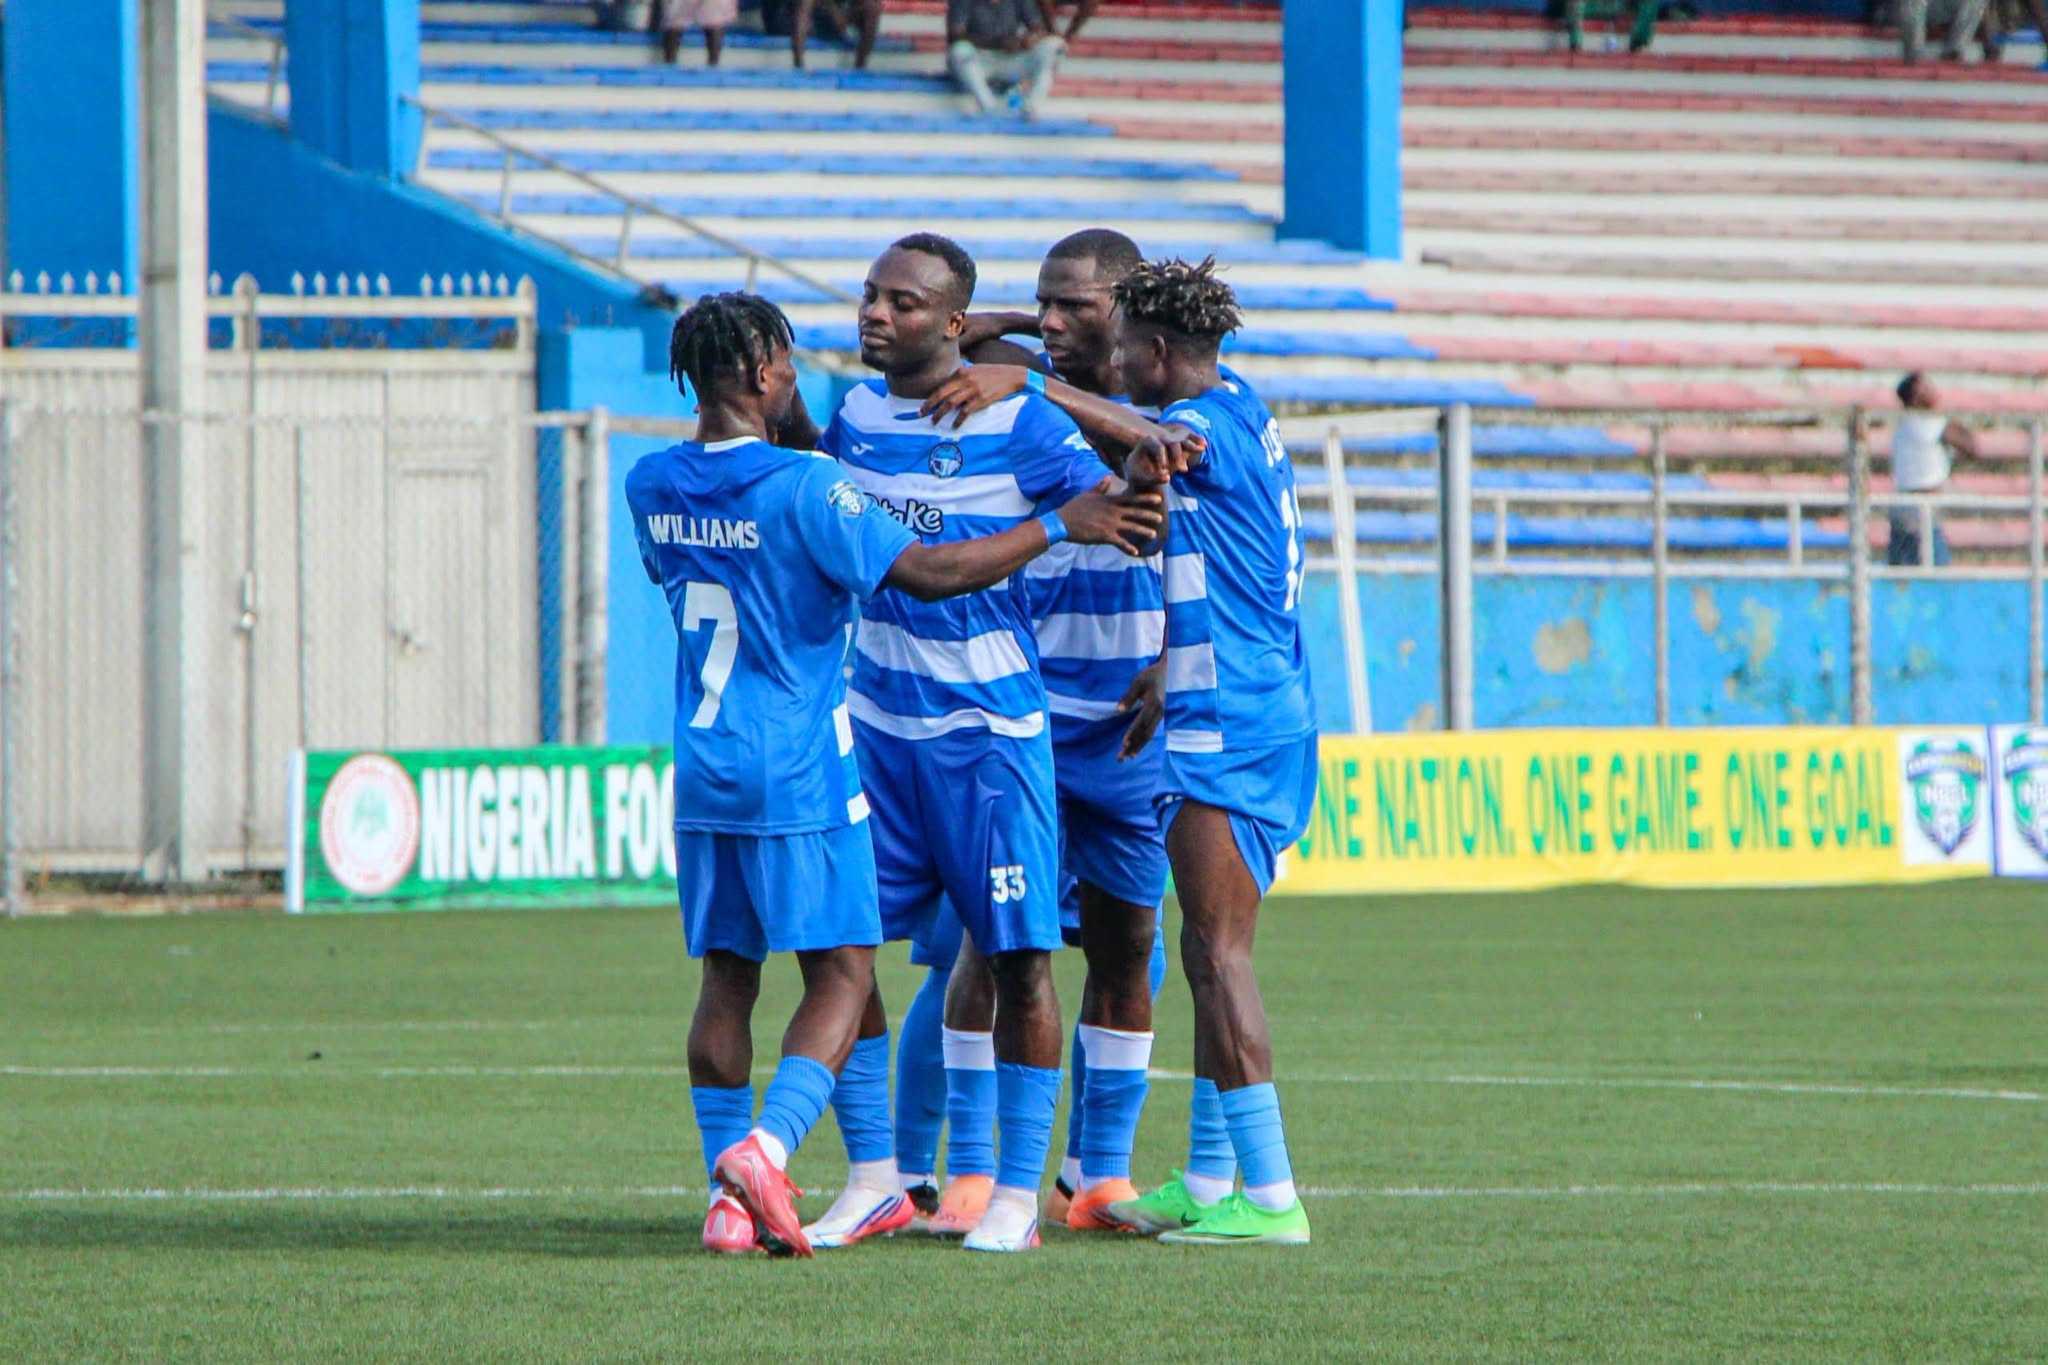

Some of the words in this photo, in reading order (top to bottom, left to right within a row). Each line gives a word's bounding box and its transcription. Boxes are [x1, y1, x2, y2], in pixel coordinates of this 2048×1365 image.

[648, 514, 760, 549] WILLIAMS
[682, 581, 739, 729] 7
[420, 765, 596, 882] NIGERIA
[1299, 757, 1362, 859] NE
[1375, 756, 1516, 858] NATION.
[1526, 754, 1594, 855] ONE
[1607, 751, 1714, 852] GAME.
[1723, 751, 1792, 850] ONE
[1804, 750, 1895, 848] GOAL
[990, 865, 1026, 904] 33
